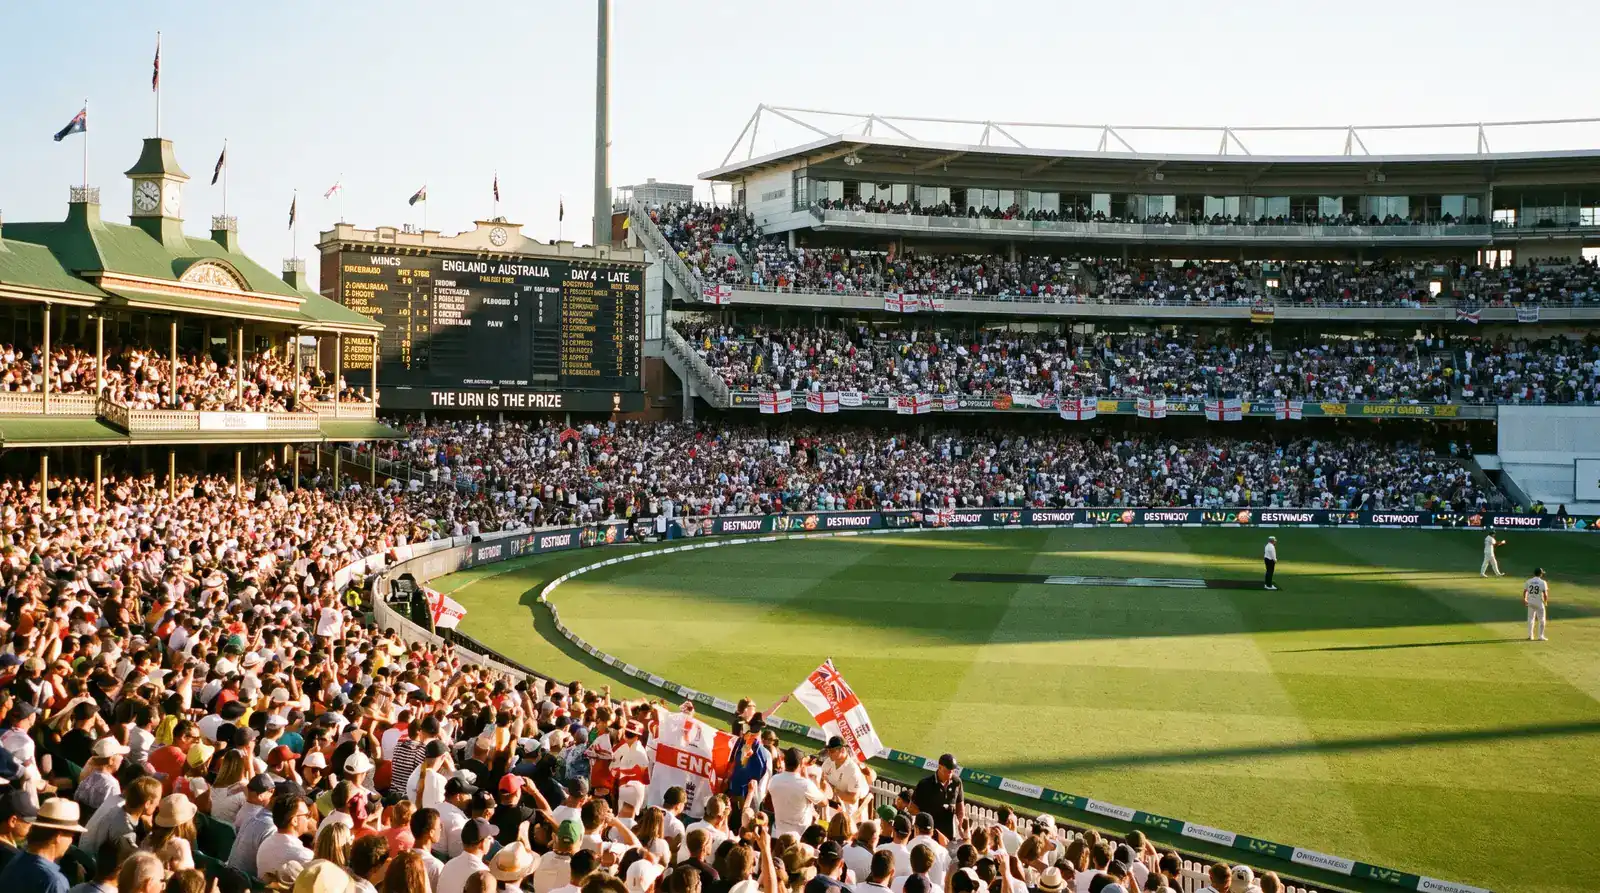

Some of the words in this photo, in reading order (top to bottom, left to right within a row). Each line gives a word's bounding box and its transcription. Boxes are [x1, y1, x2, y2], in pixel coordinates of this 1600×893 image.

[442, 260, 488, 274] ENGLAND
[490, 266, 496, 274] v
[498, 264, 550, 278] AUSTRALIA
[572, 270, 589, 280] DAY
[591, 270, 597, 281] 4
[608, 272, 630, 282] LATE
[431, 392, 455, 406] THE
[458, 393, 484, 406] URN
[488, 393, 499, 407] IS
[502, 394, 525, 407] THE
[528, 394, 562, 408] PRIZE
[1529, 585, 1540, 594] 29
